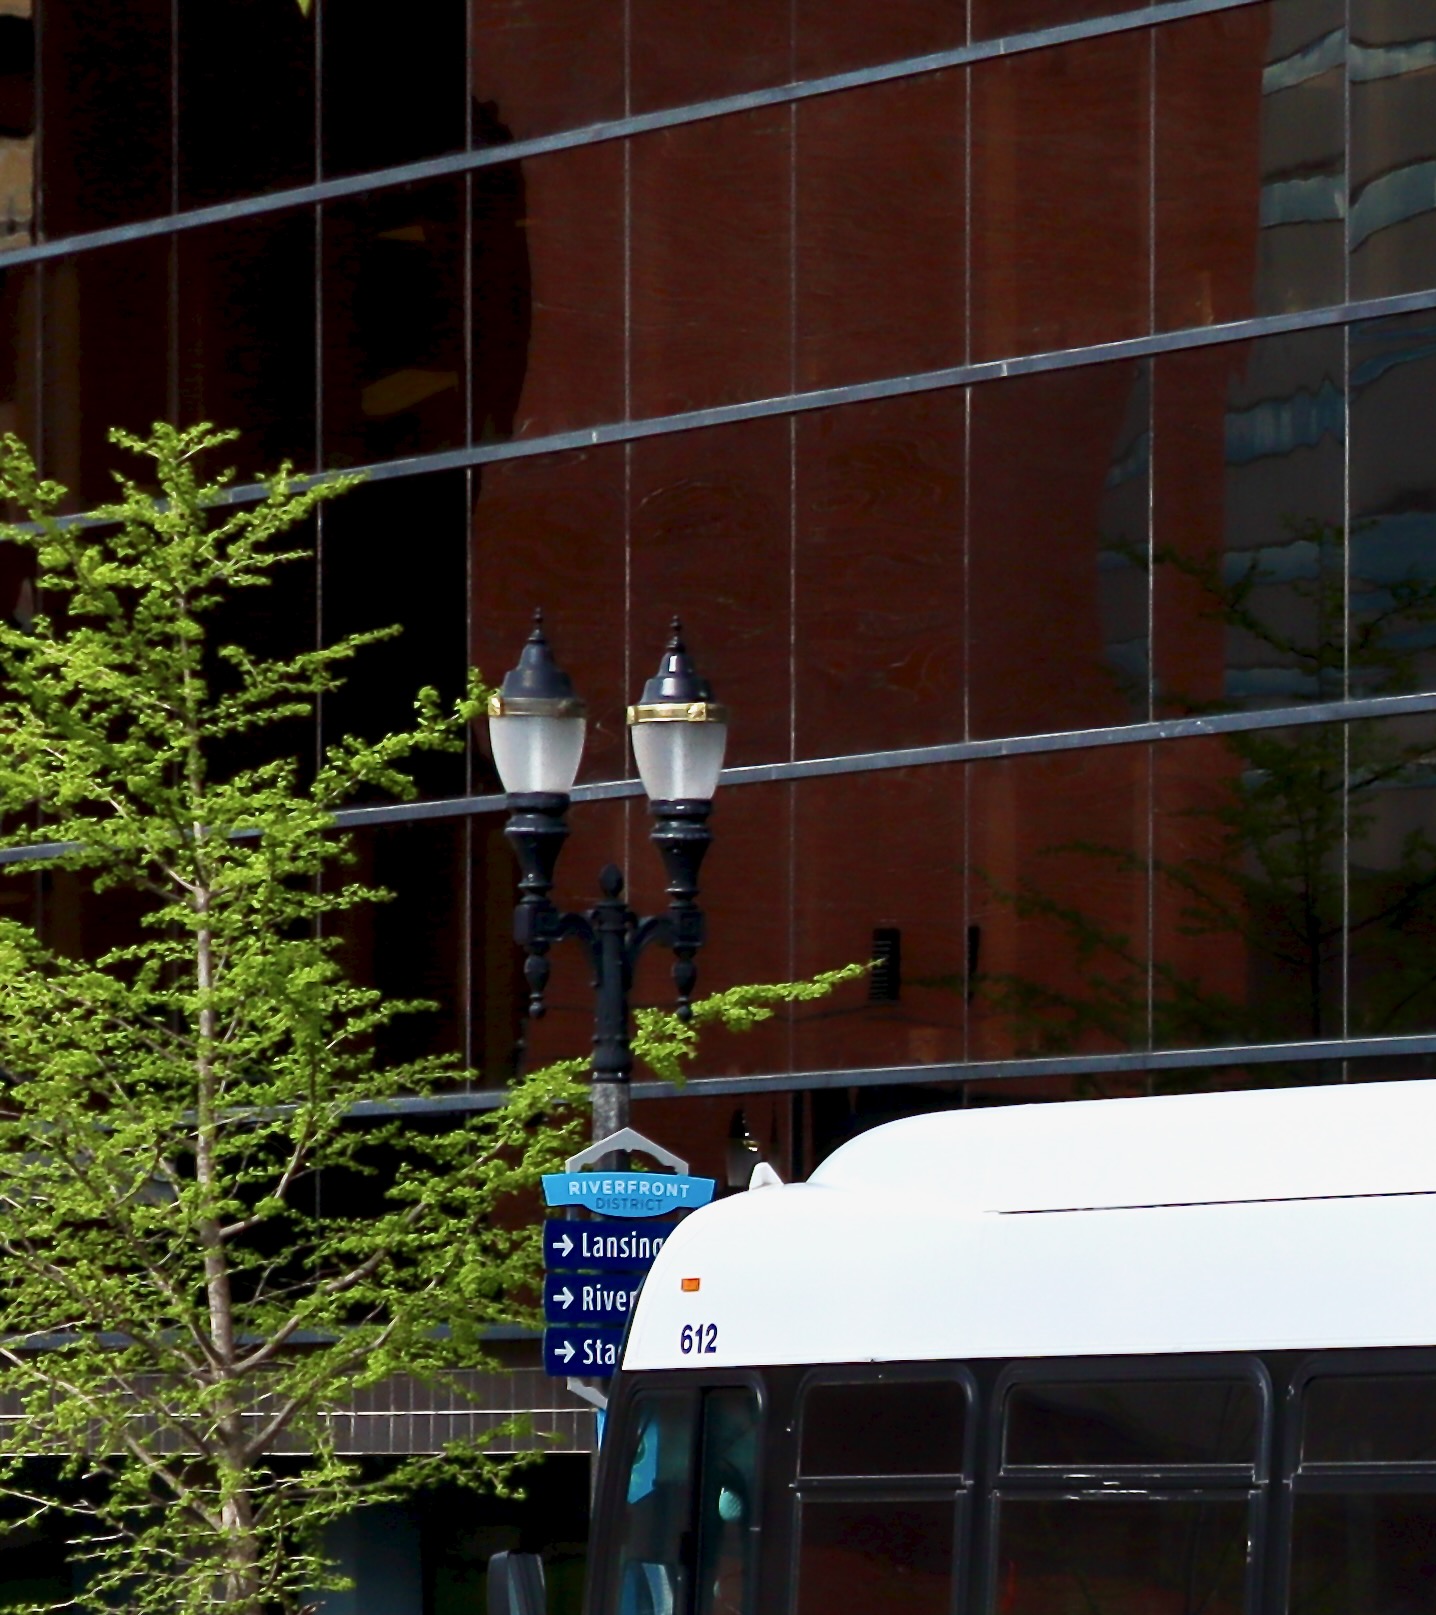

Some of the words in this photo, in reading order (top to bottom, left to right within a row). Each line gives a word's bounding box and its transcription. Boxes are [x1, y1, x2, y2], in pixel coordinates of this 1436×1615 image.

[568, 1179, 690, 1198] RIVERFRONT
[596, 1197, 664, 1211] DISTRICT
[680, 1323, 718, 1355] 612
[583, 1339, 621, 1365] Sta
